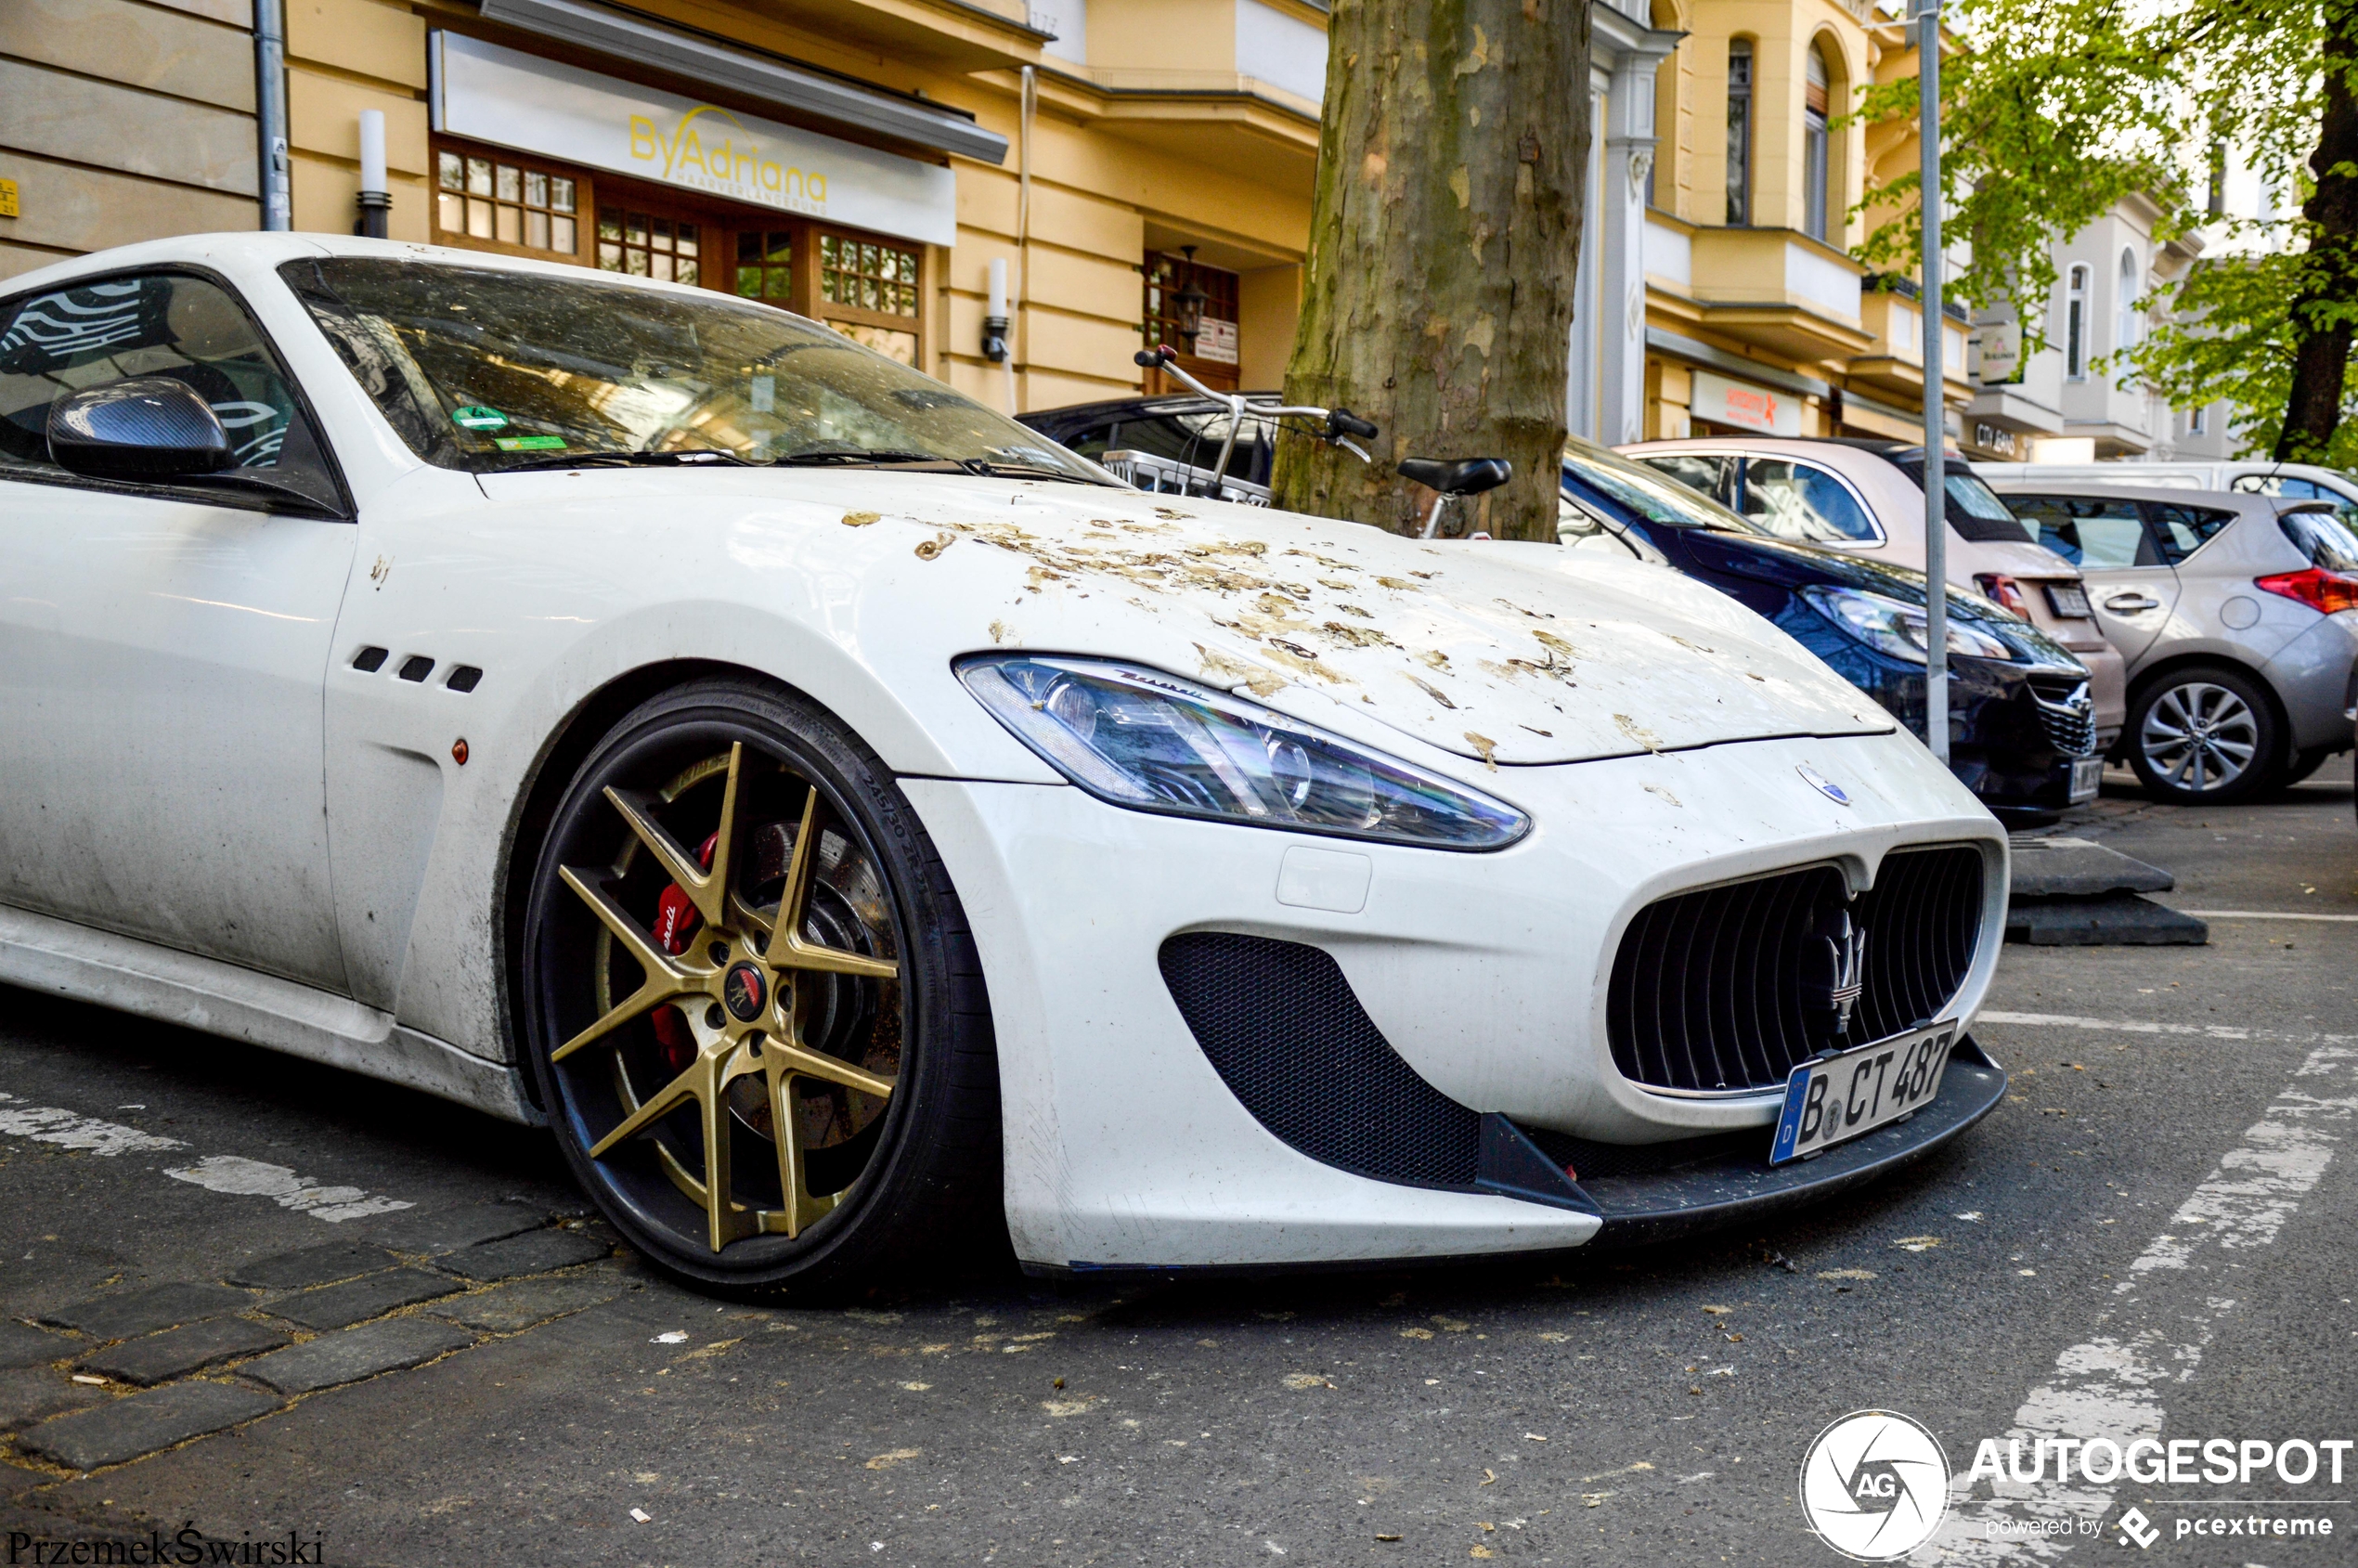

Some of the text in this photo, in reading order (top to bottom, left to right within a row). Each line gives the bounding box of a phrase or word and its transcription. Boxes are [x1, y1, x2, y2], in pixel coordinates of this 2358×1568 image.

[629, 105, 827, 203] ByAdriana
[862, 774, 906, 838] 245/30
[1798, 1030, 1953, 1145] B CT 487
[1781, 1123, 1793, 1144] D
